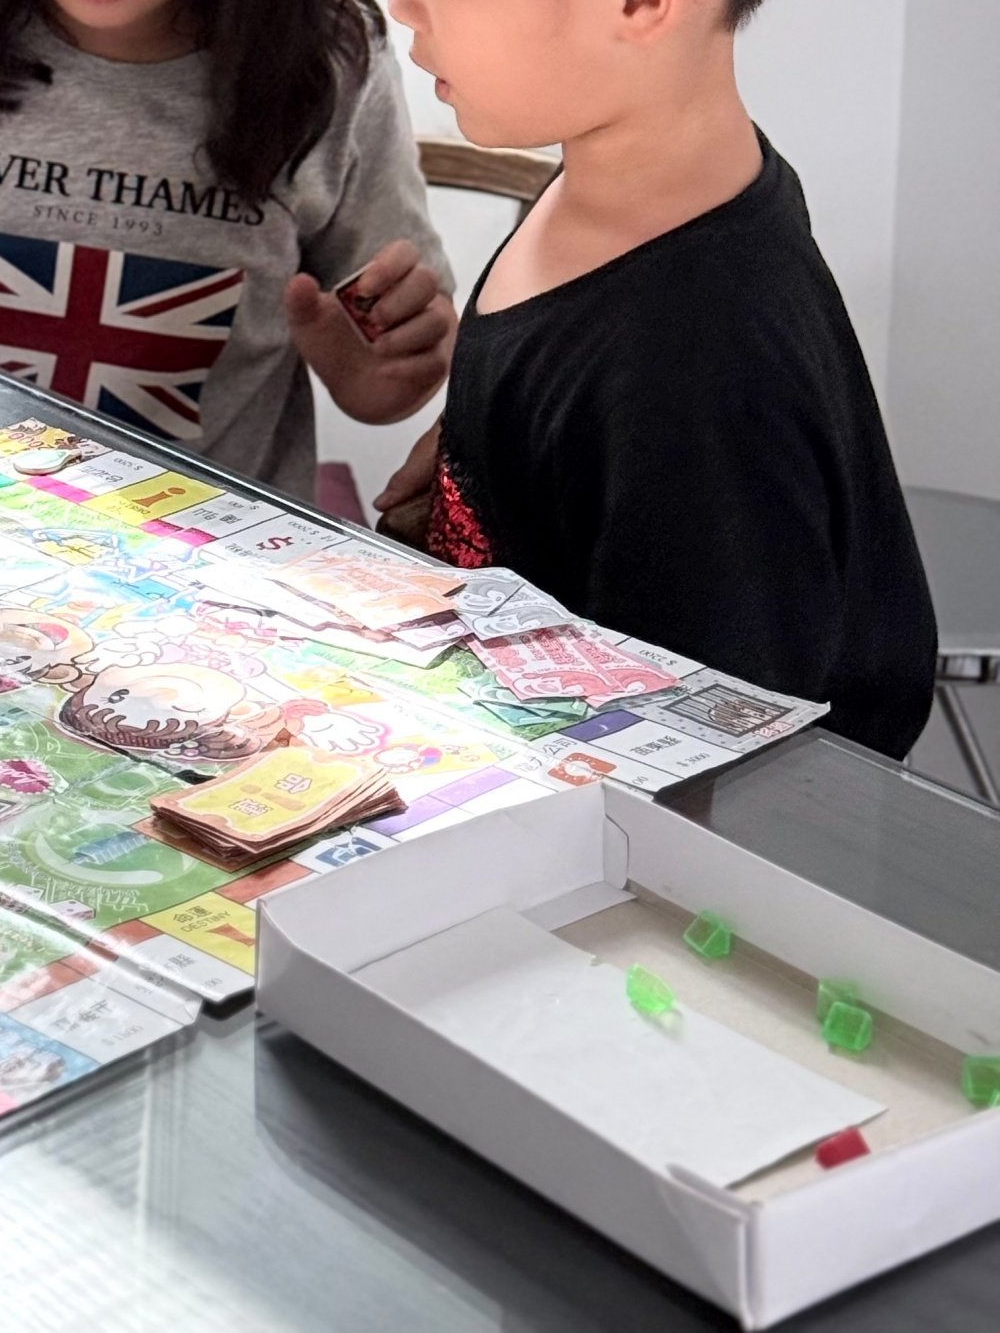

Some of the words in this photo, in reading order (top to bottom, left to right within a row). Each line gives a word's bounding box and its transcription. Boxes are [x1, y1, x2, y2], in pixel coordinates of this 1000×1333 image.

[87, 168, 266, 227] THAMES
[33, 204, 99, 227] SINCE
[112, 217, 164, 237] 1993
[180, 910, 232, 933] DESTINY
